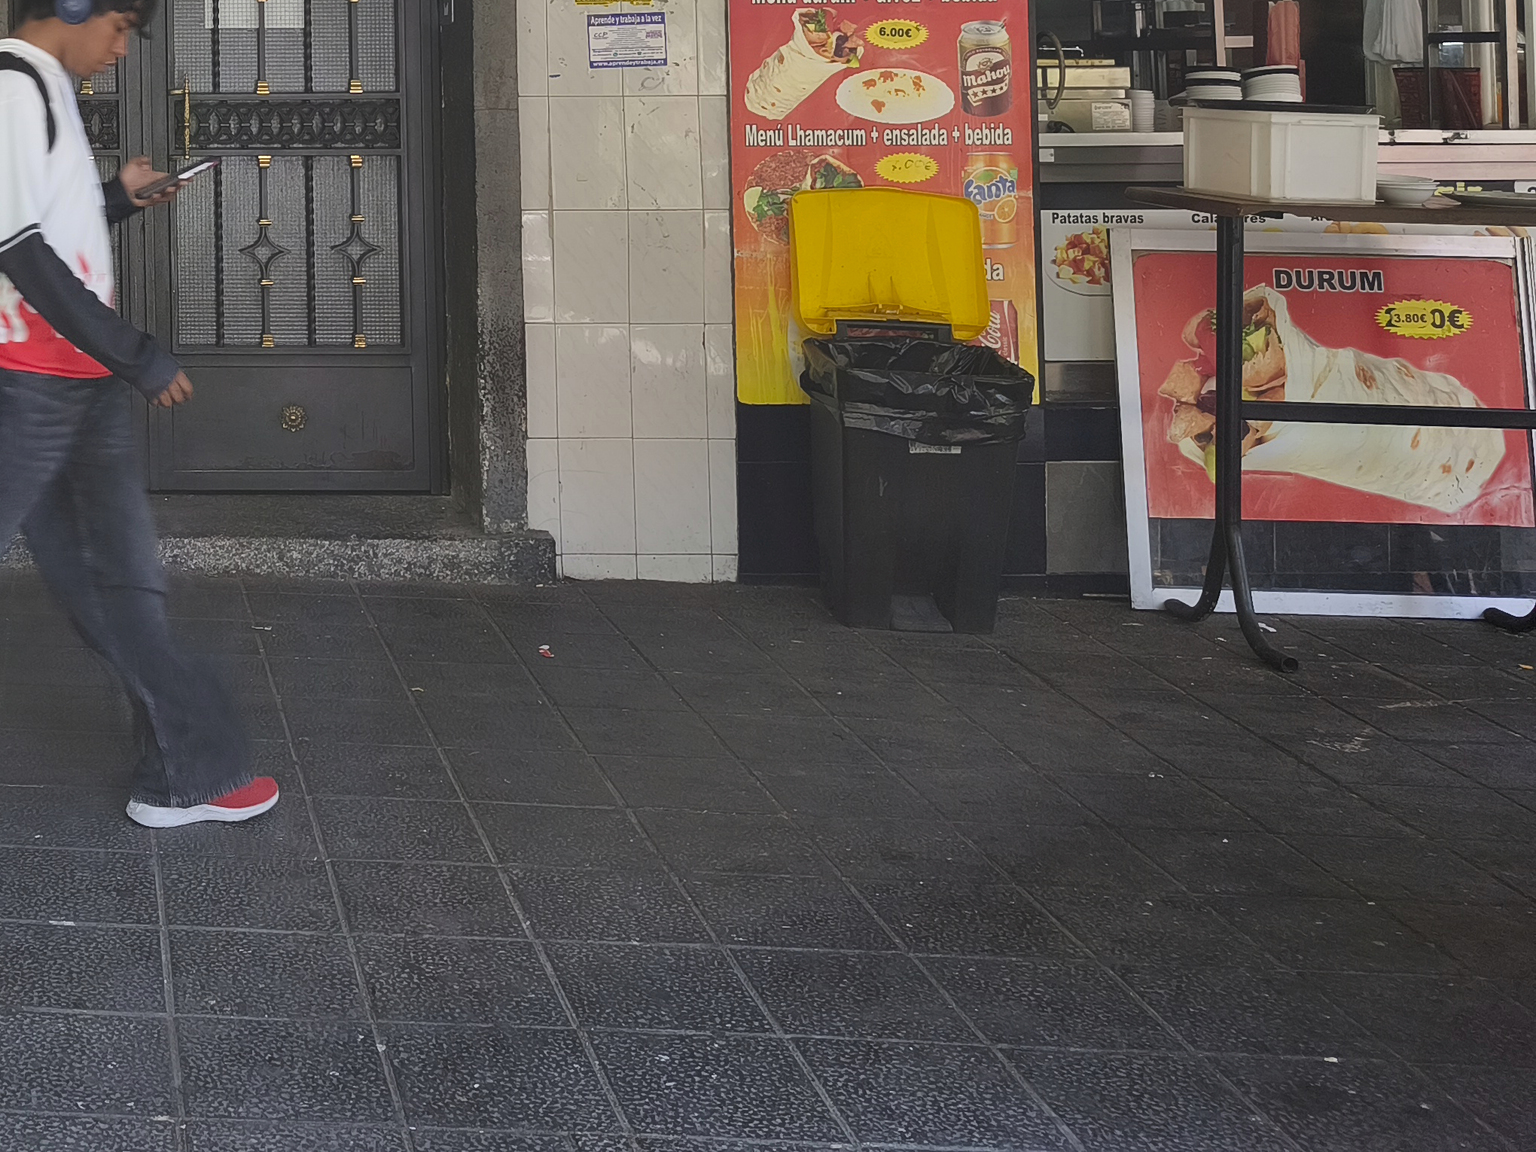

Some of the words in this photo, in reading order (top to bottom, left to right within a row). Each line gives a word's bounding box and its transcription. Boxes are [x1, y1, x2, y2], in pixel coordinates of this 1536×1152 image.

[590, 15, 615, 26] Aprende
[620, 14, 641, 25] trabaja
[878, 26, 913, 39] 6.00€
[963, 64, 1010, 87] Mahou
[745, 124, 784, 147] Menú
[788, 124, 866, 147] Lhamacum
[883, 124, 948, 146] ensalada
[965, 123, 1013, 145] bebida
[1051, 212, 1099, 225] Patatas
[1102, 211, 1144, 225] bravas
[1273, 268, 1384, 292] DURUM
[1394, 313, 1427, 324] 3.80€
